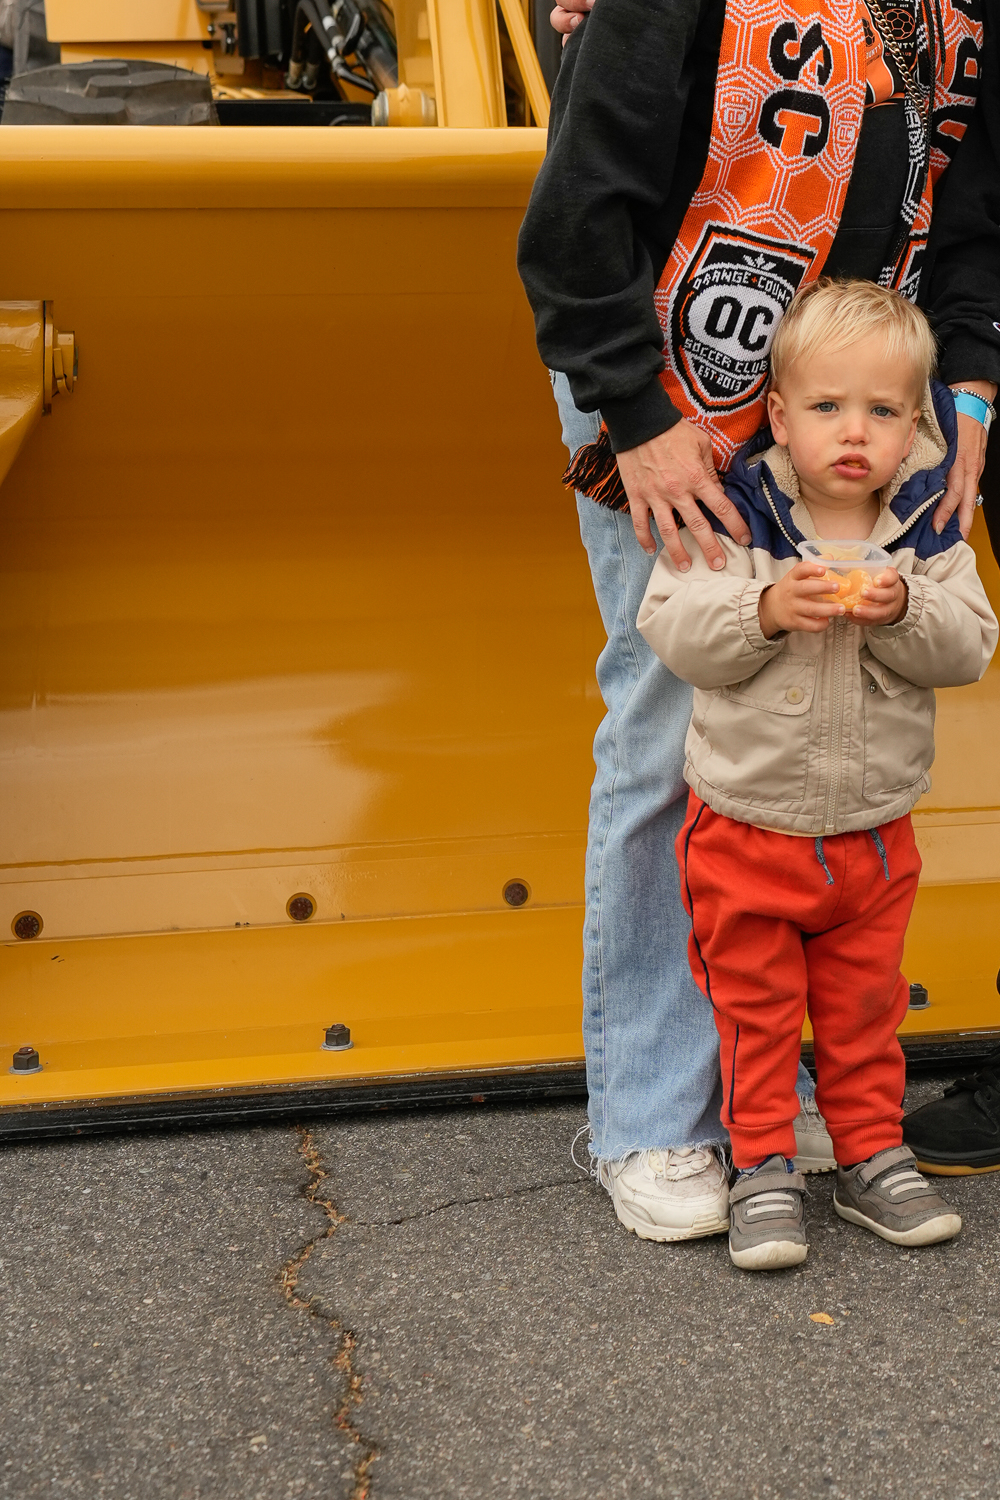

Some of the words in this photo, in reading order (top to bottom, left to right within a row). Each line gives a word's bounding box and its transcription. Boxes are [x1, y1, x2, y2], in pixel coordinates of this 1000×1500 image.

[759, 19, 832, 157] SC
[692, 268, 751, 291] ORANGE
[704, 295, 774, 352] OC
[683, 337, 731, 369] SOCCER
[734, 360, 769, 374] CLUB
